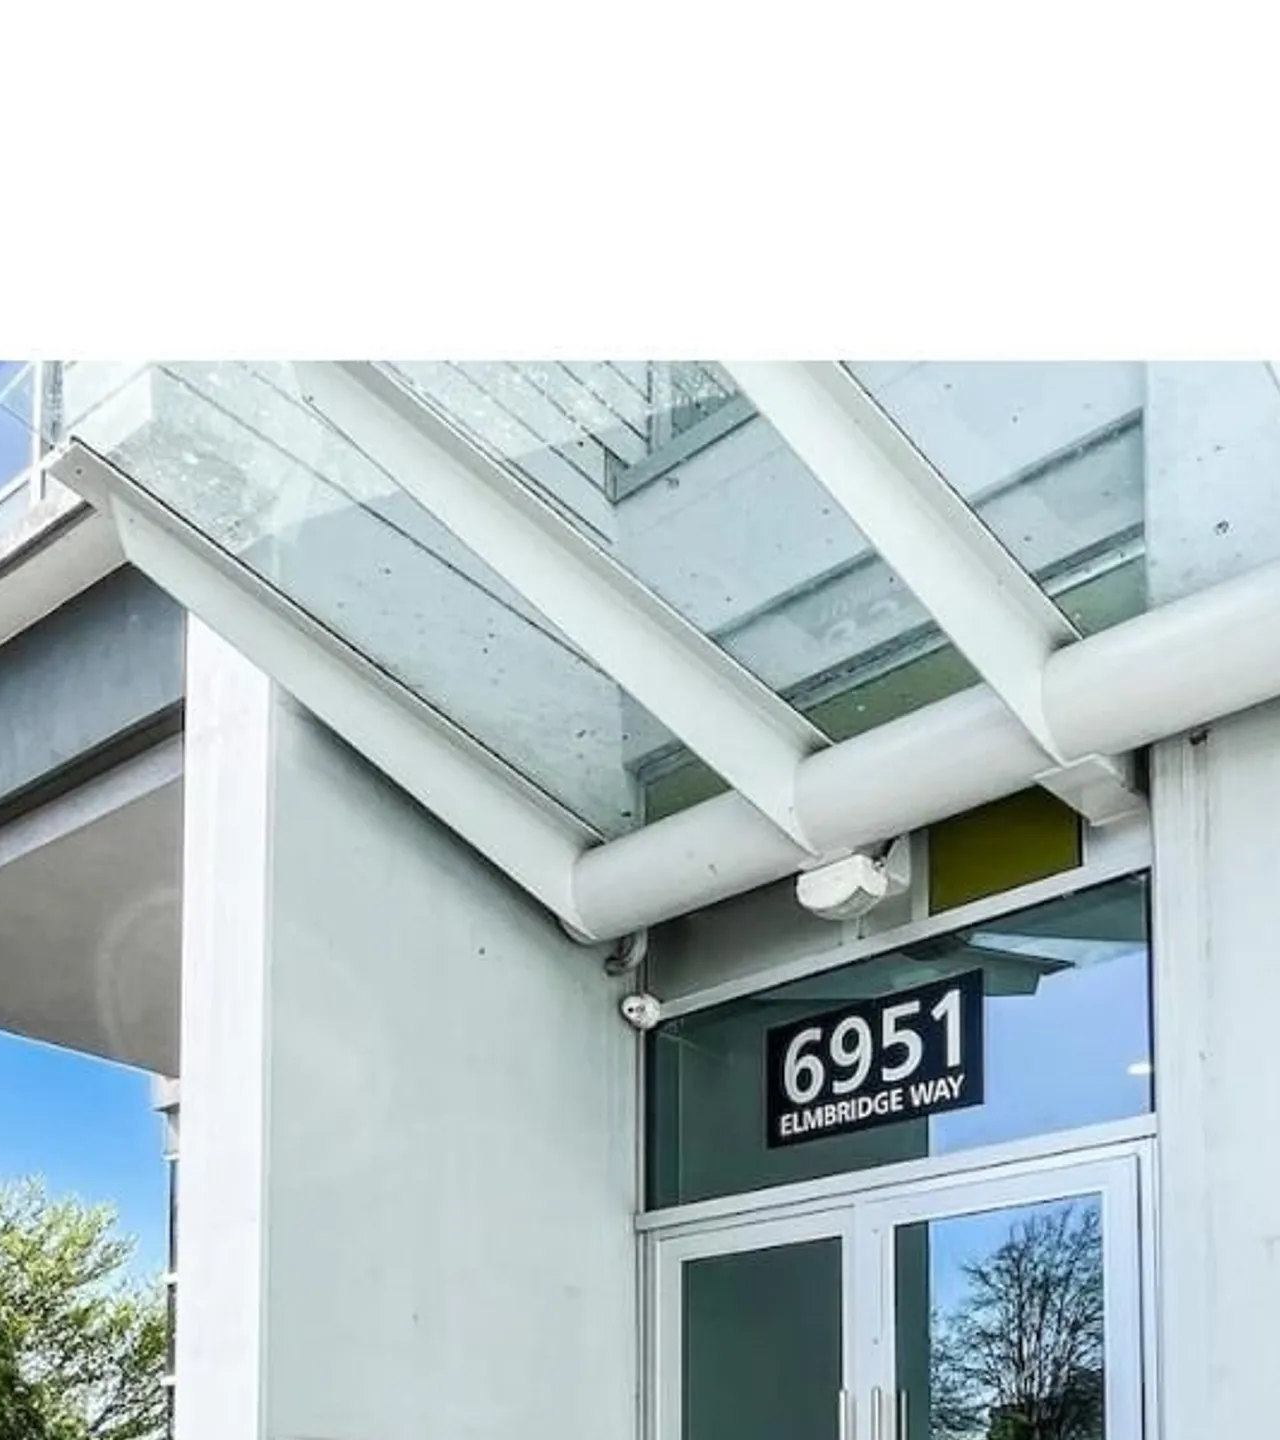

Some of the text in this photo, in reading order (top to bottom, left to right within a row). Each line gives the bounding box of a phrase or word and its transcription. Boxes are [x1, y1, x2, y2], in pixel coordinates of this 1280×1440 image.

[783, 989, 961, 1104] 6951
[780, 1074, 965, 1136] ELMBRIDGE WAY
